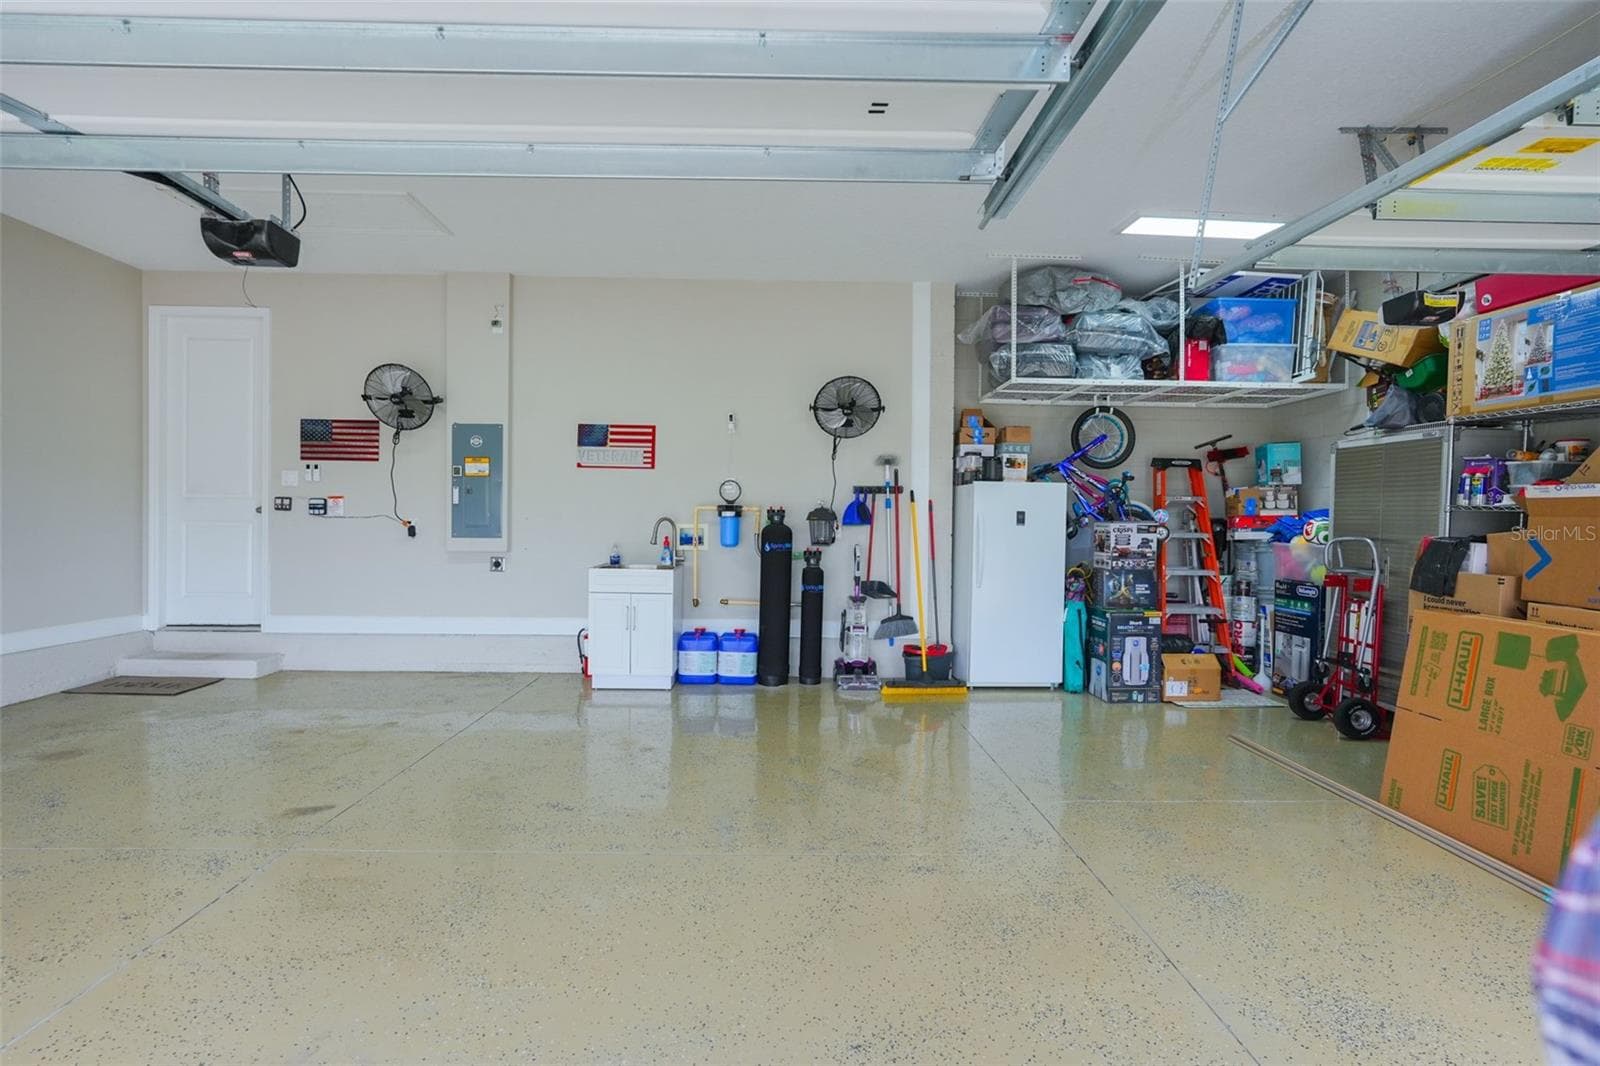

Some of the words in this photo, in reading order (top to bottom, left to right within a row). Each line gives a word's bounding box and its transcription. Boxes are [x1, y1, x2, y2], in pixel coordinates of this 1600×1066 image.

[577, 448, 642, 463] VETERAN
[1427, 597, 1445, 605] could
[1446, 599, 1467, 607] never
[1450, 636, 1473, 704] U-HAUL
[1478, 699, 1491, 732] LARGE
[1485, 676, 1497, 697] BOX
[1438, 754, 1455, 805] U-HAUL
[1475, 776, 1487, 818] SAVE!
